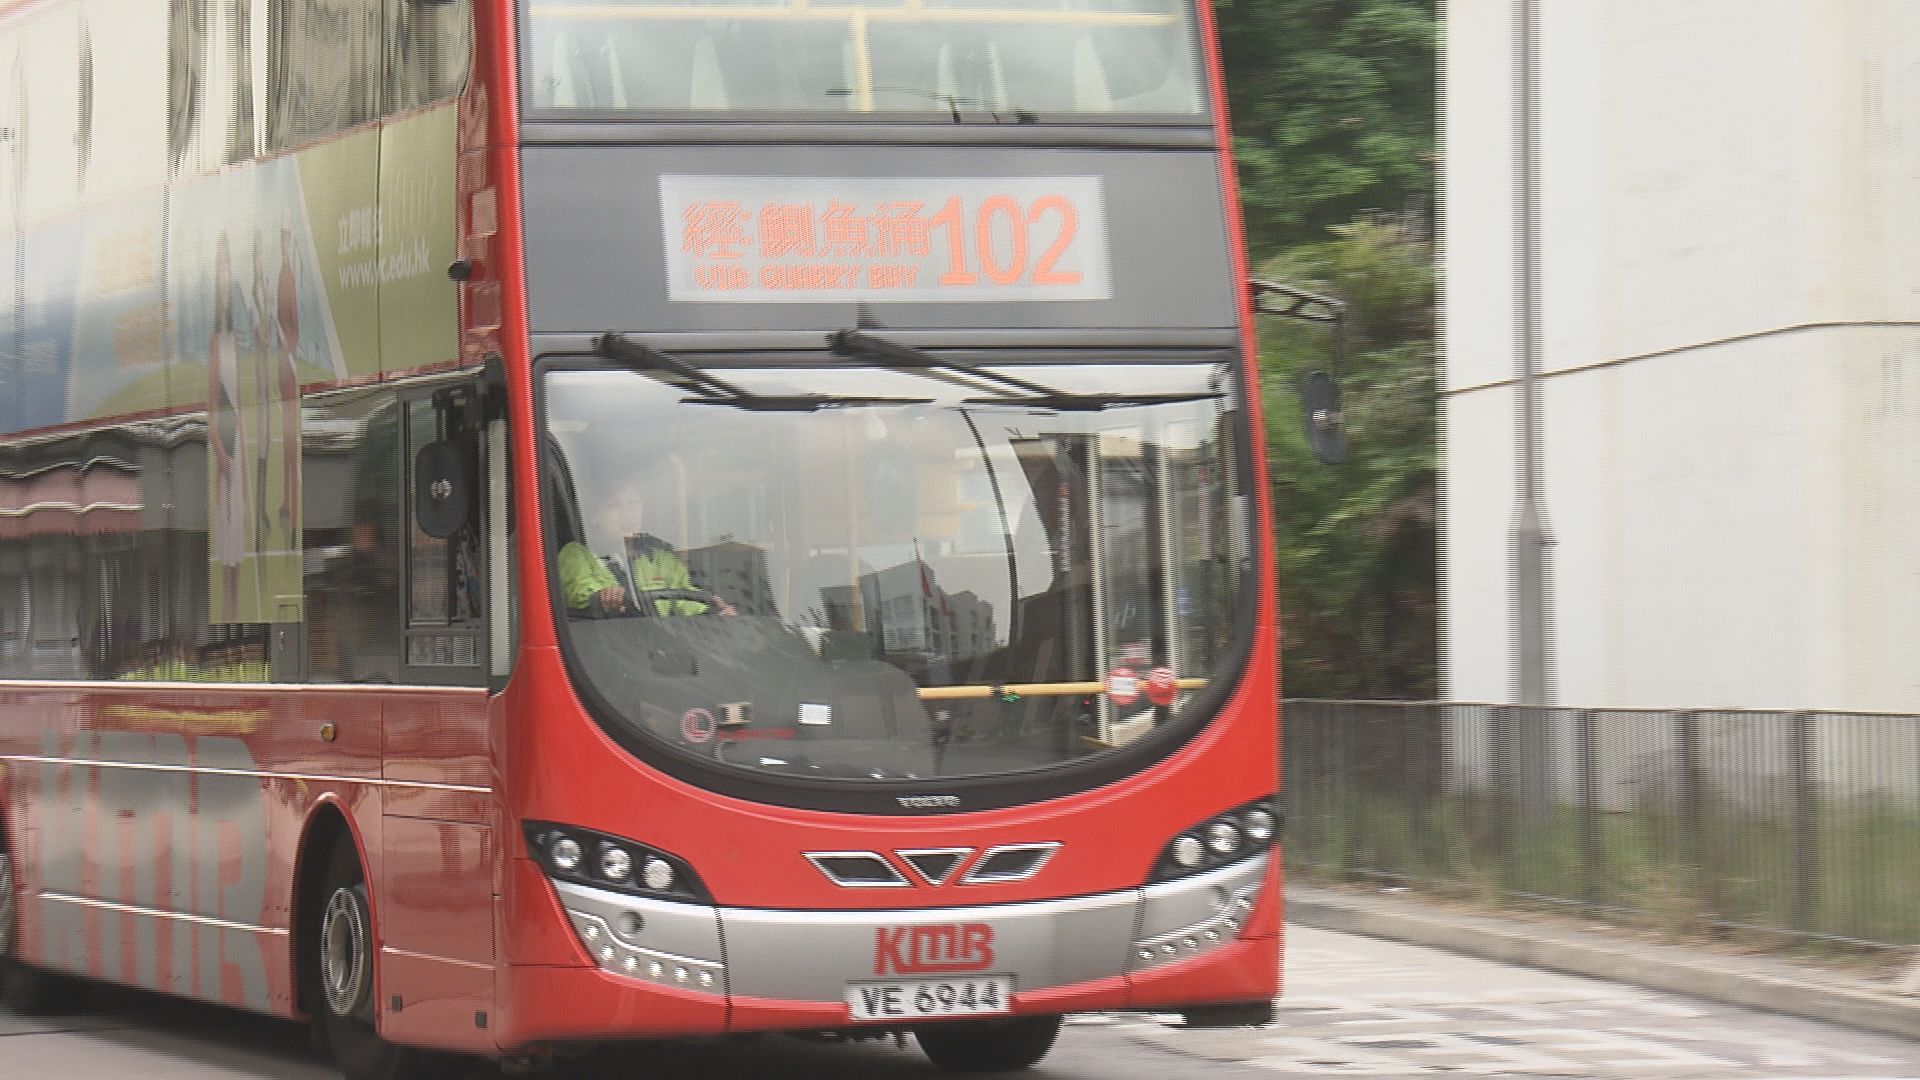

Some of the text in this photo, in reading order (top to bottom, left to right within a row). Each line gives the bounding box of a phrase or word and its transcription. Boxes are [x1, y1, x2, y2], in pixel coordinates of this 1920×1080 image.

[930, 194, 1083, 286] 102
[758, 263, 861, 290] QUARRY
[867, 263, 920, 289] BAY
[895, 795, 961, 808] VOLVO
[860, 981, 999, 1016] VE 6944
